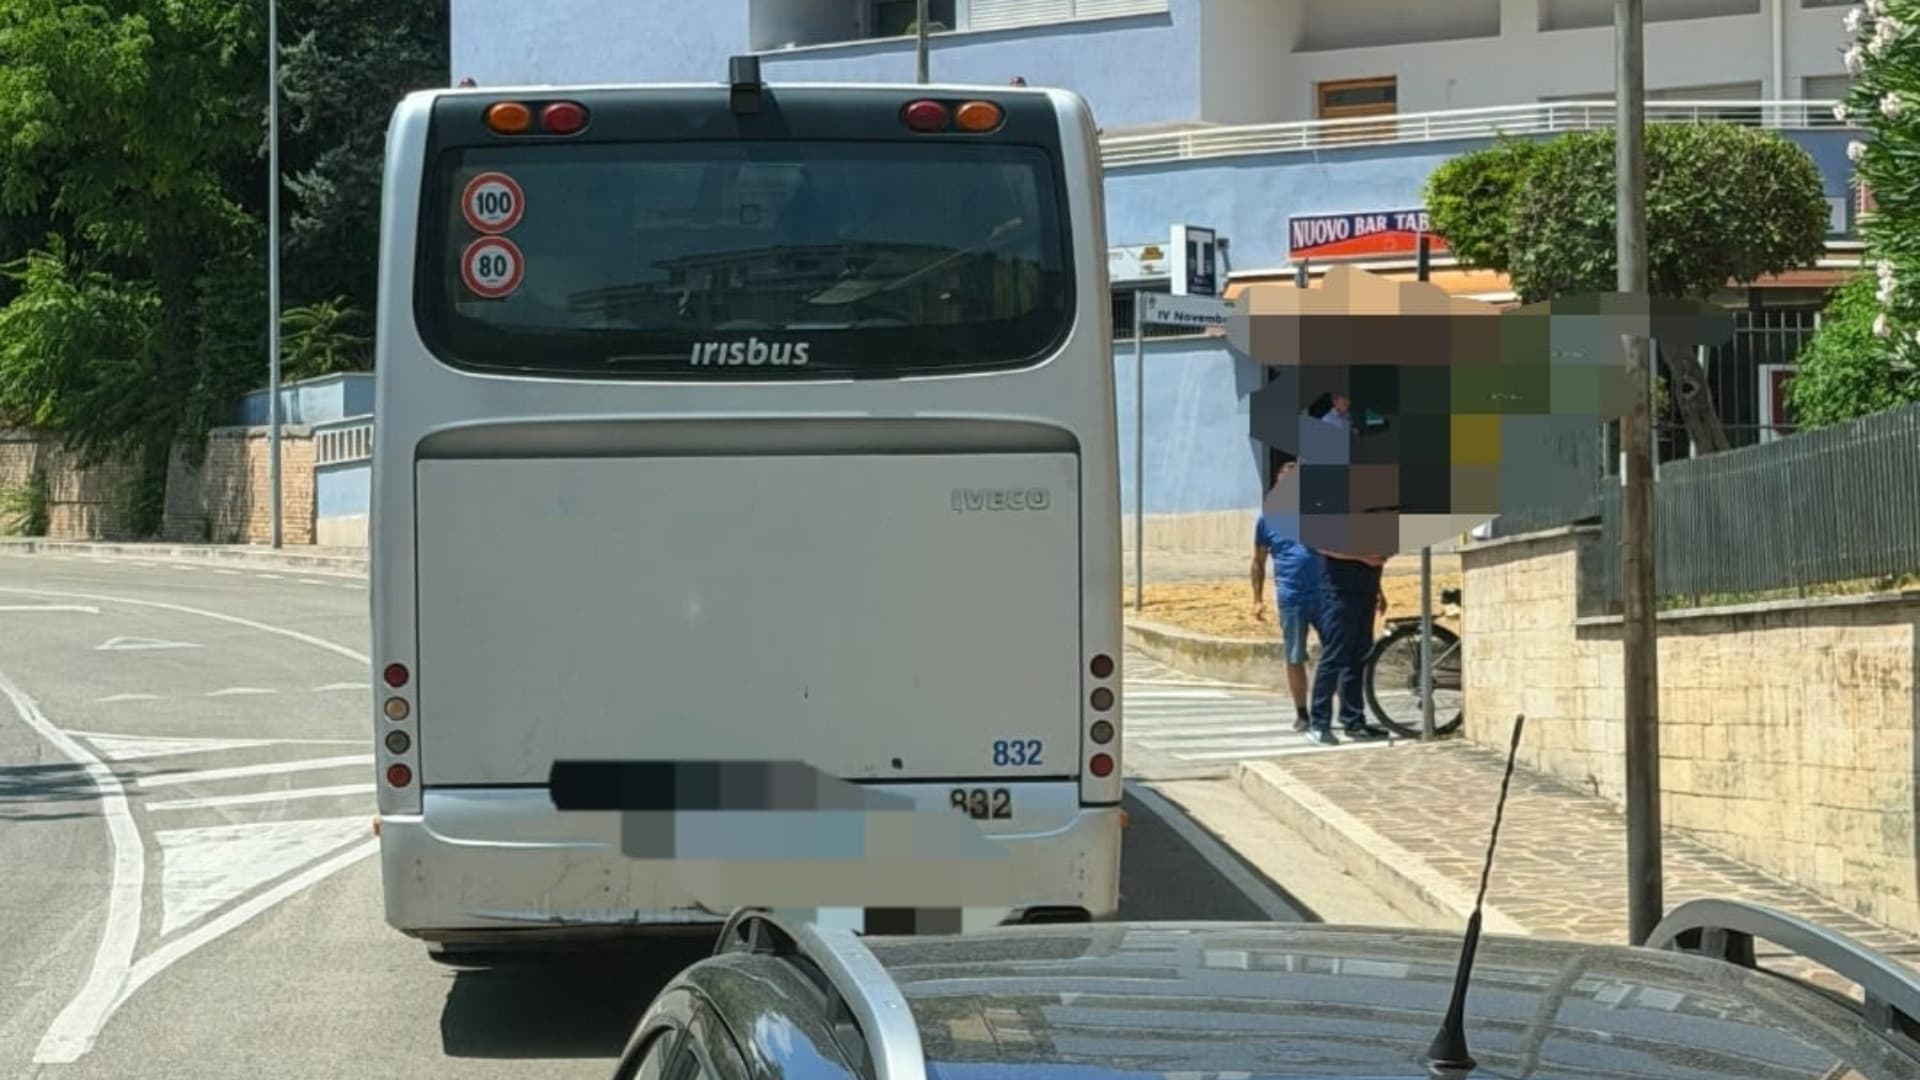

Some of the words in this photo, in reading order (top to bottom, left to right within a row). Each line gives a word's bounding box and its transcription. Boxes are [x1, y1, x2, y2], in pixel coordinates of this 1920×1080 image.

[477, 191, 512, 214] 100
[1293, 217, 1350, 249] NUOVO
[1355, 214, 1387, 236] BAR
[479, 254, 507, 278] 80
[1157, 309, 1170, 321] IV
[690, 337, 810, 366] irisbus
[951, 487, 1051, 512] IVECO
[993, 739, 1043, 766] 832
